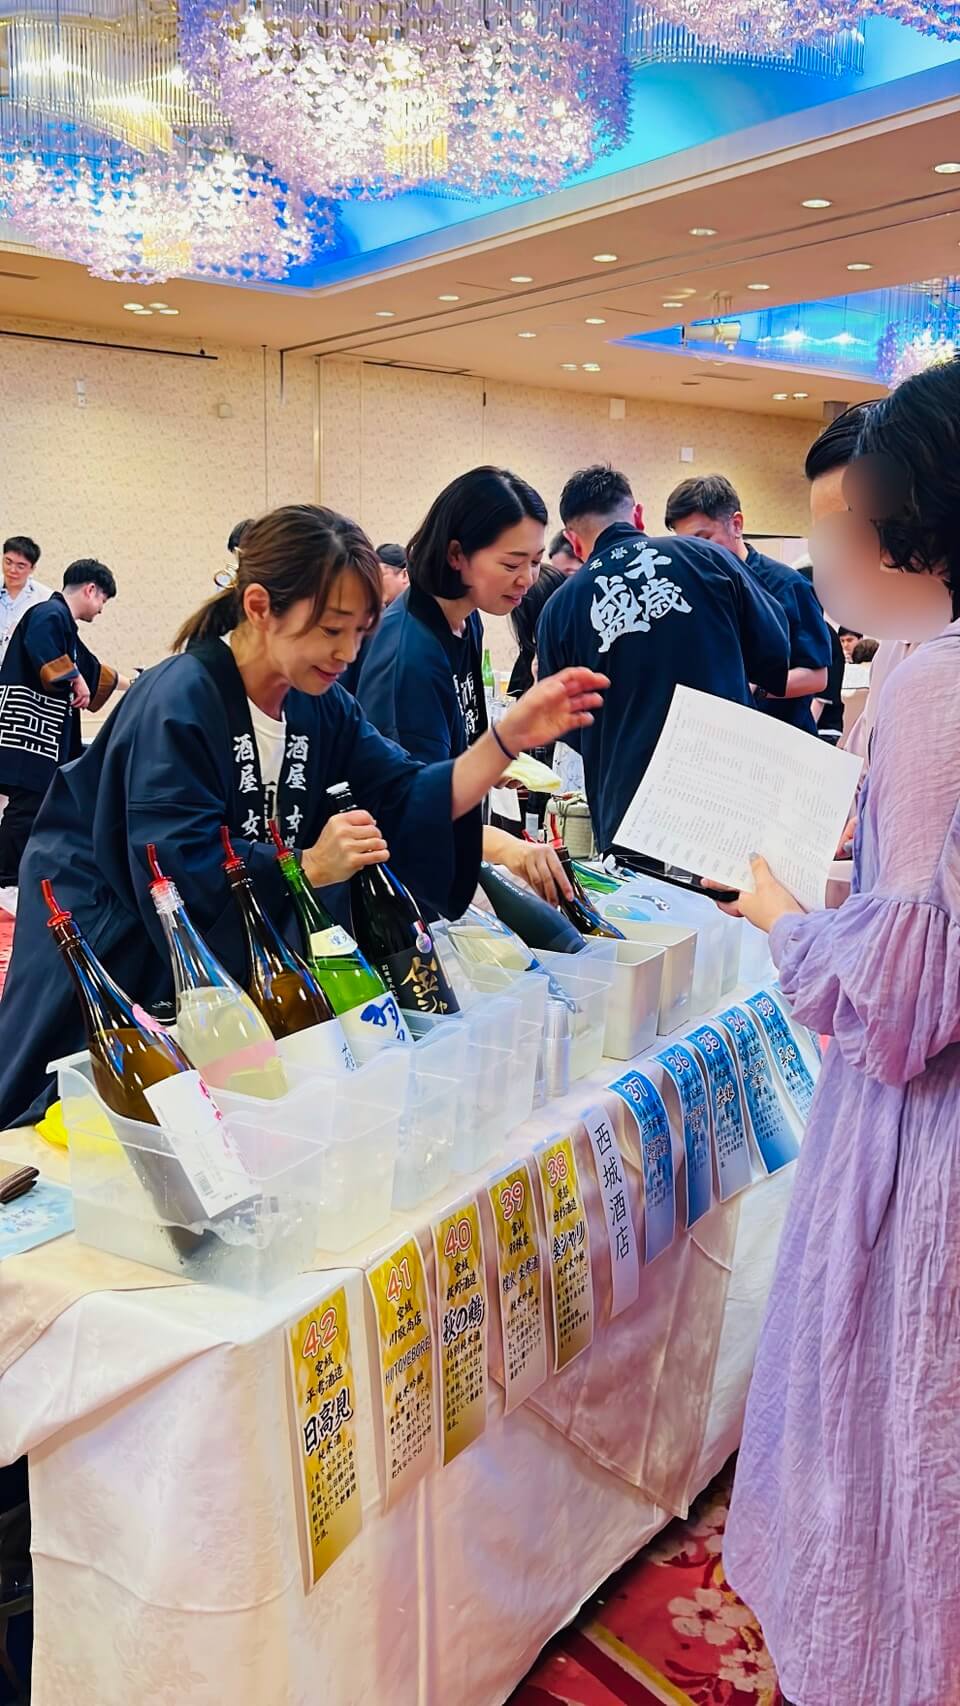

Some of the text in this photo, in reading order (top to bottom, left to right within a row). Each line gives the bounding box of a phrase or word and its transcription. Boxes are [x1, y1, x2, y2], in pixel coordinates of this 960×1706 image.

[233, 733, 259, 793] 酒屋
[285, 734, 309, 791] 酒屋
[728, 1014, 746, 1033] 34
[756, 997, 775, 1018] 33
[698, 1030, 720, 1054] 35
[666, 1051, 690, 1074] 36
[623, 1076, 648, 1103] 37
[546, 1150, 568, 1188] 38
[500, 1180, 524, 1220] 39
[595, 1122, 630, 1261] 西城酒店
[444, 1217, 472, 1258] 40
[553, 1221, 585, 1263] 金シャリ
[386, 1257, 412, 1301] 41
[454, 1257, 469, 1276] 宮城
[397, 1299, 413, 1322] 宮城
[443, 1294, 485, 1346] 萩の鶴
[303, 1308, 338, 1358] 42
[447, 1329, 480, 1361] 特別純米酒
[315, 1352, 334, 1376] 宮城
[395, 1369, 424, 1405] 純米吟醸
[304, 1386, 353, 1456] 日高見
[318, 1433, 341, 1463] 純米酒
